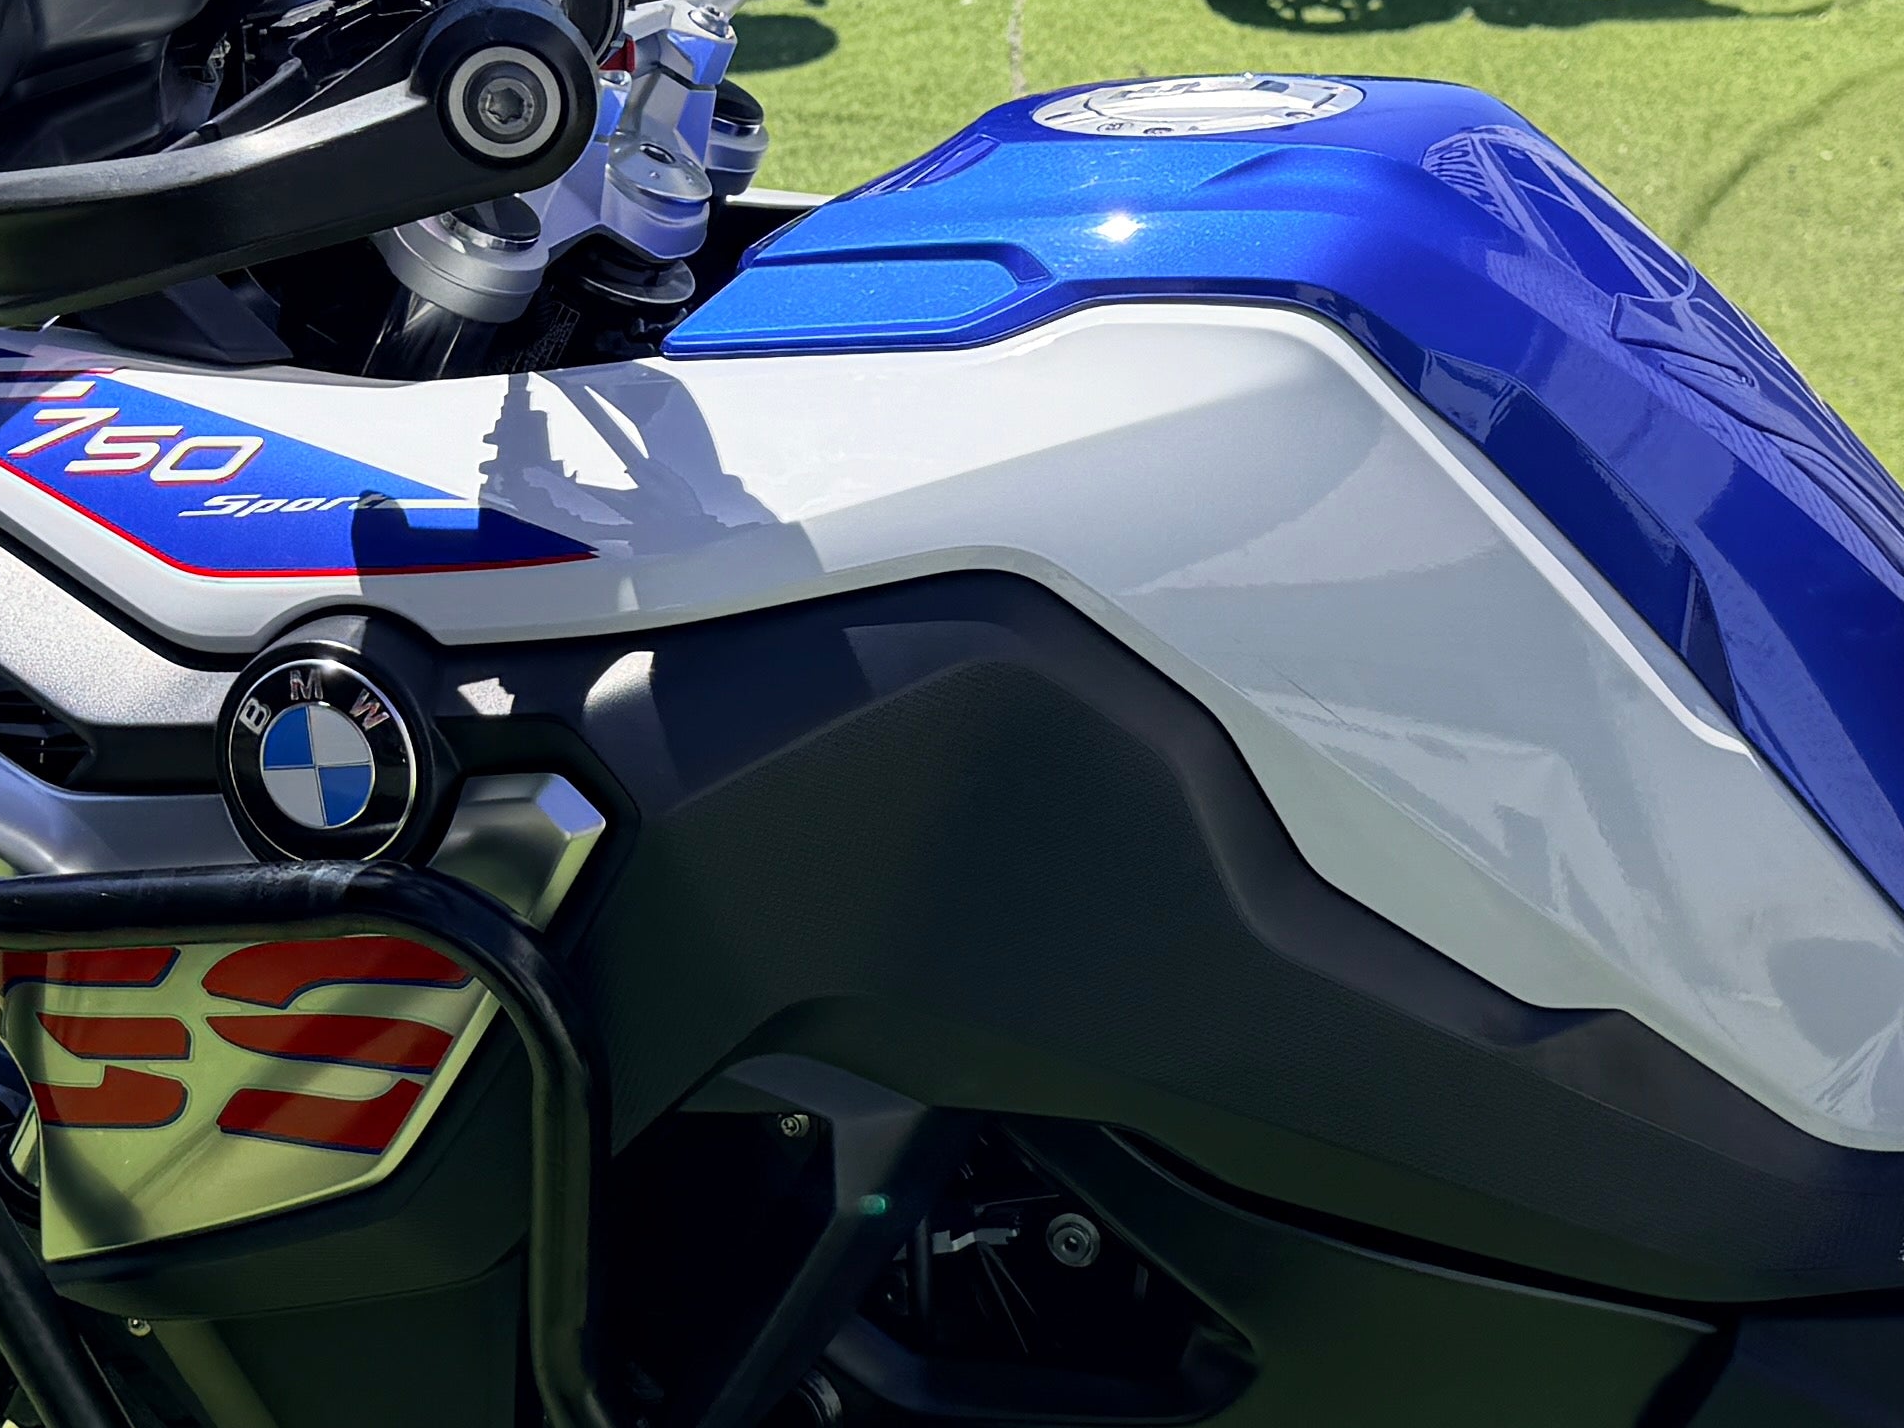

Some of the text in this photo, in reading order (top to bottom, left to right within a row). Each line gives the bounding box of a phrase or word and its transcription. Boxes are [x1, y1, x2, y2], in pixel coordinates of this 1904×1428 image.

[7, 406, 265, 487] 750
[178, 492, 484, 518] Sport
[238, 669, 390, 736] BMW
